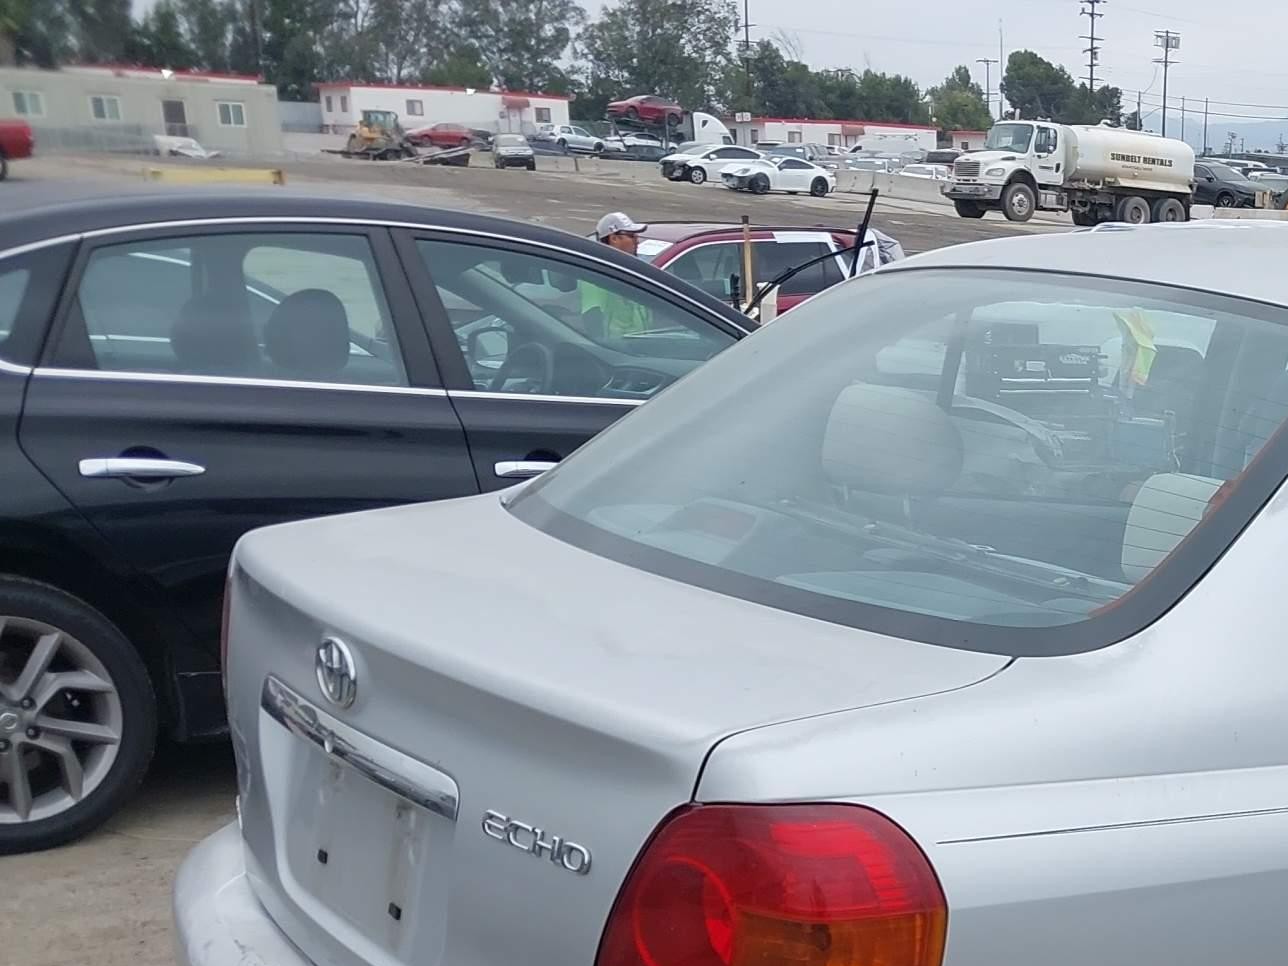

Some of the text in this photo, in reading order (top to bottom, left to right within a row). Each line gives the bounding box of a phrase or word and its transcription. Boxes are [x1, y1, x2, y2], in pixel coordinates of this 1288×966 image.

[1110, 153, 1141, 164] SUNBELT
[1142, 157, 1173, 168] RENTALS
[481, 809, 592, 876] ECHO
